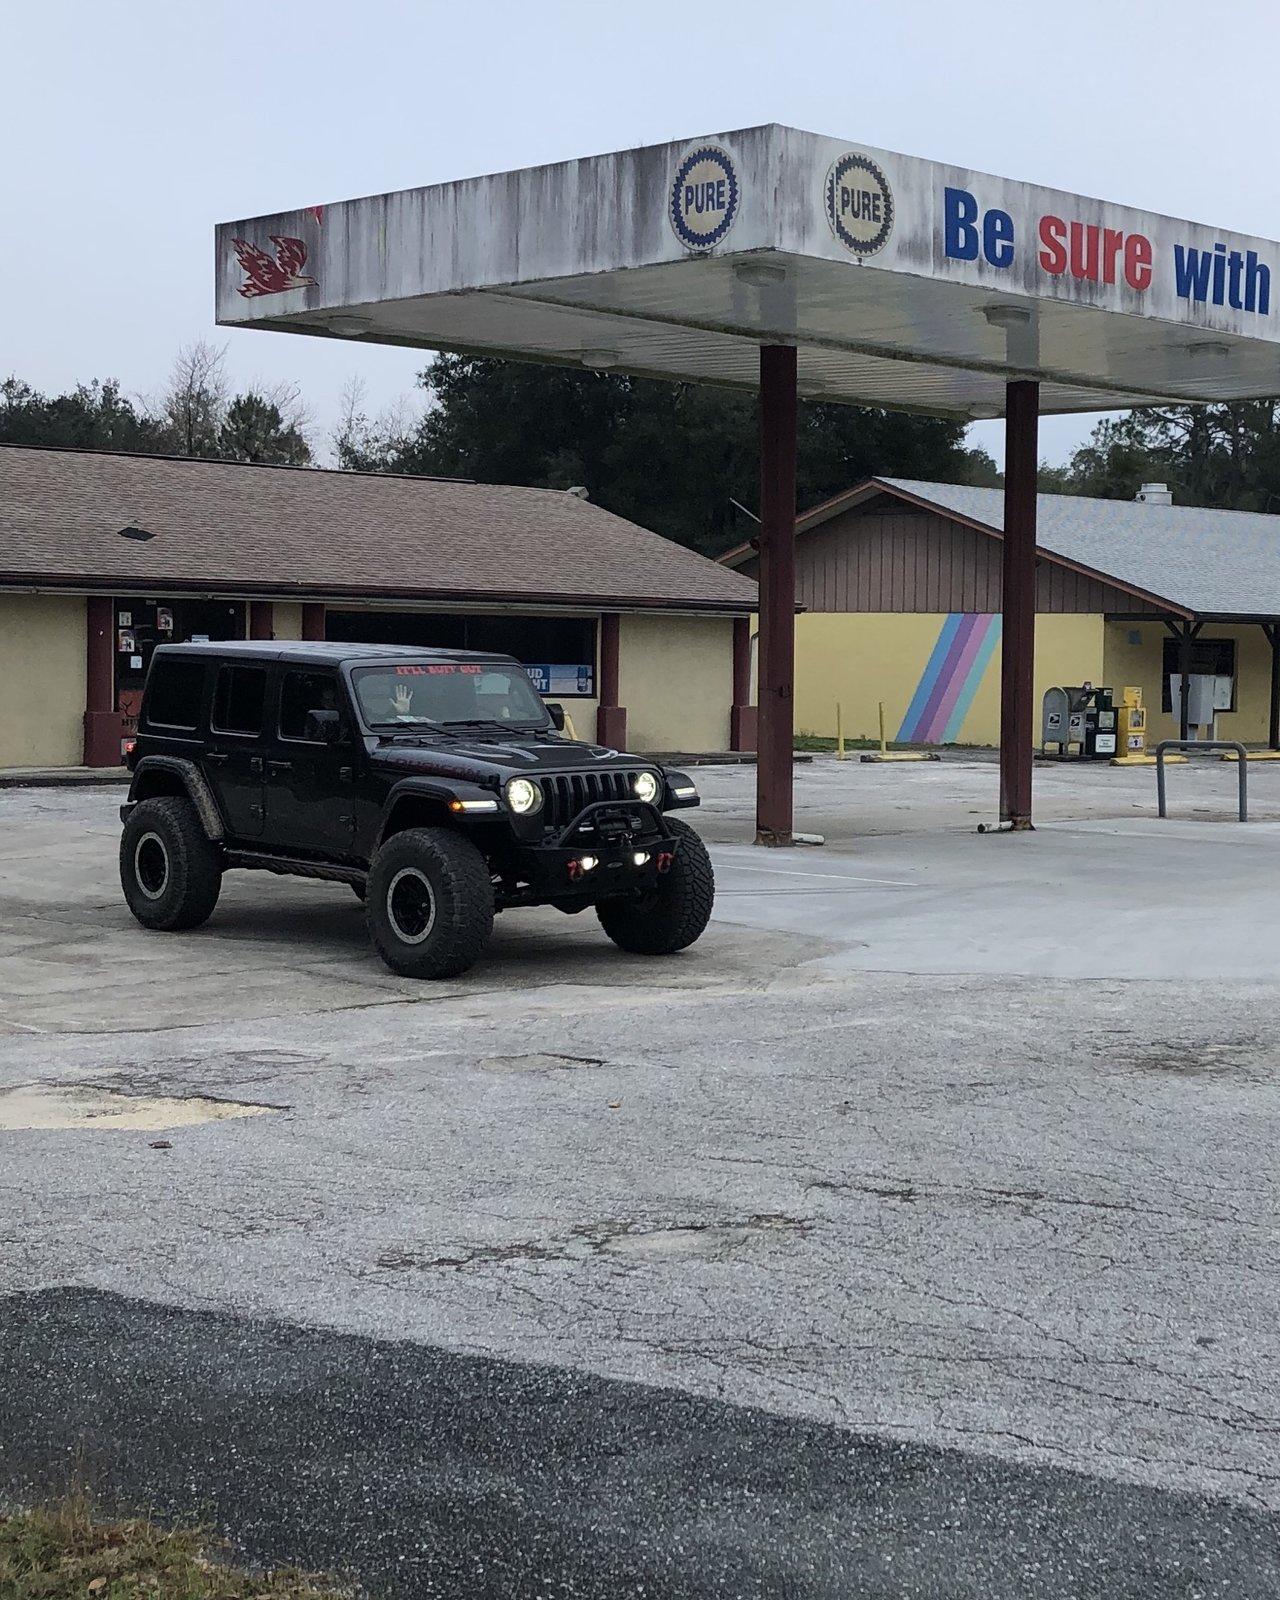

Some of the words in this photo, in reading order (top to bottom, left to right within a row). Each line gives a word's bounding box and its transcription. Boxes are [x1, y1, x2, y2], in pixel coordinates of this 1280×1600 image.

[685, 179, 726, 215] PURE
[841, 187, 882, 223] PURE
[944, 187, 1014, 268] Be
[1039, 215, 1152, 290] sure
[1174, 243, 1271, 315] with
[526, 668, 544, 679] UD
